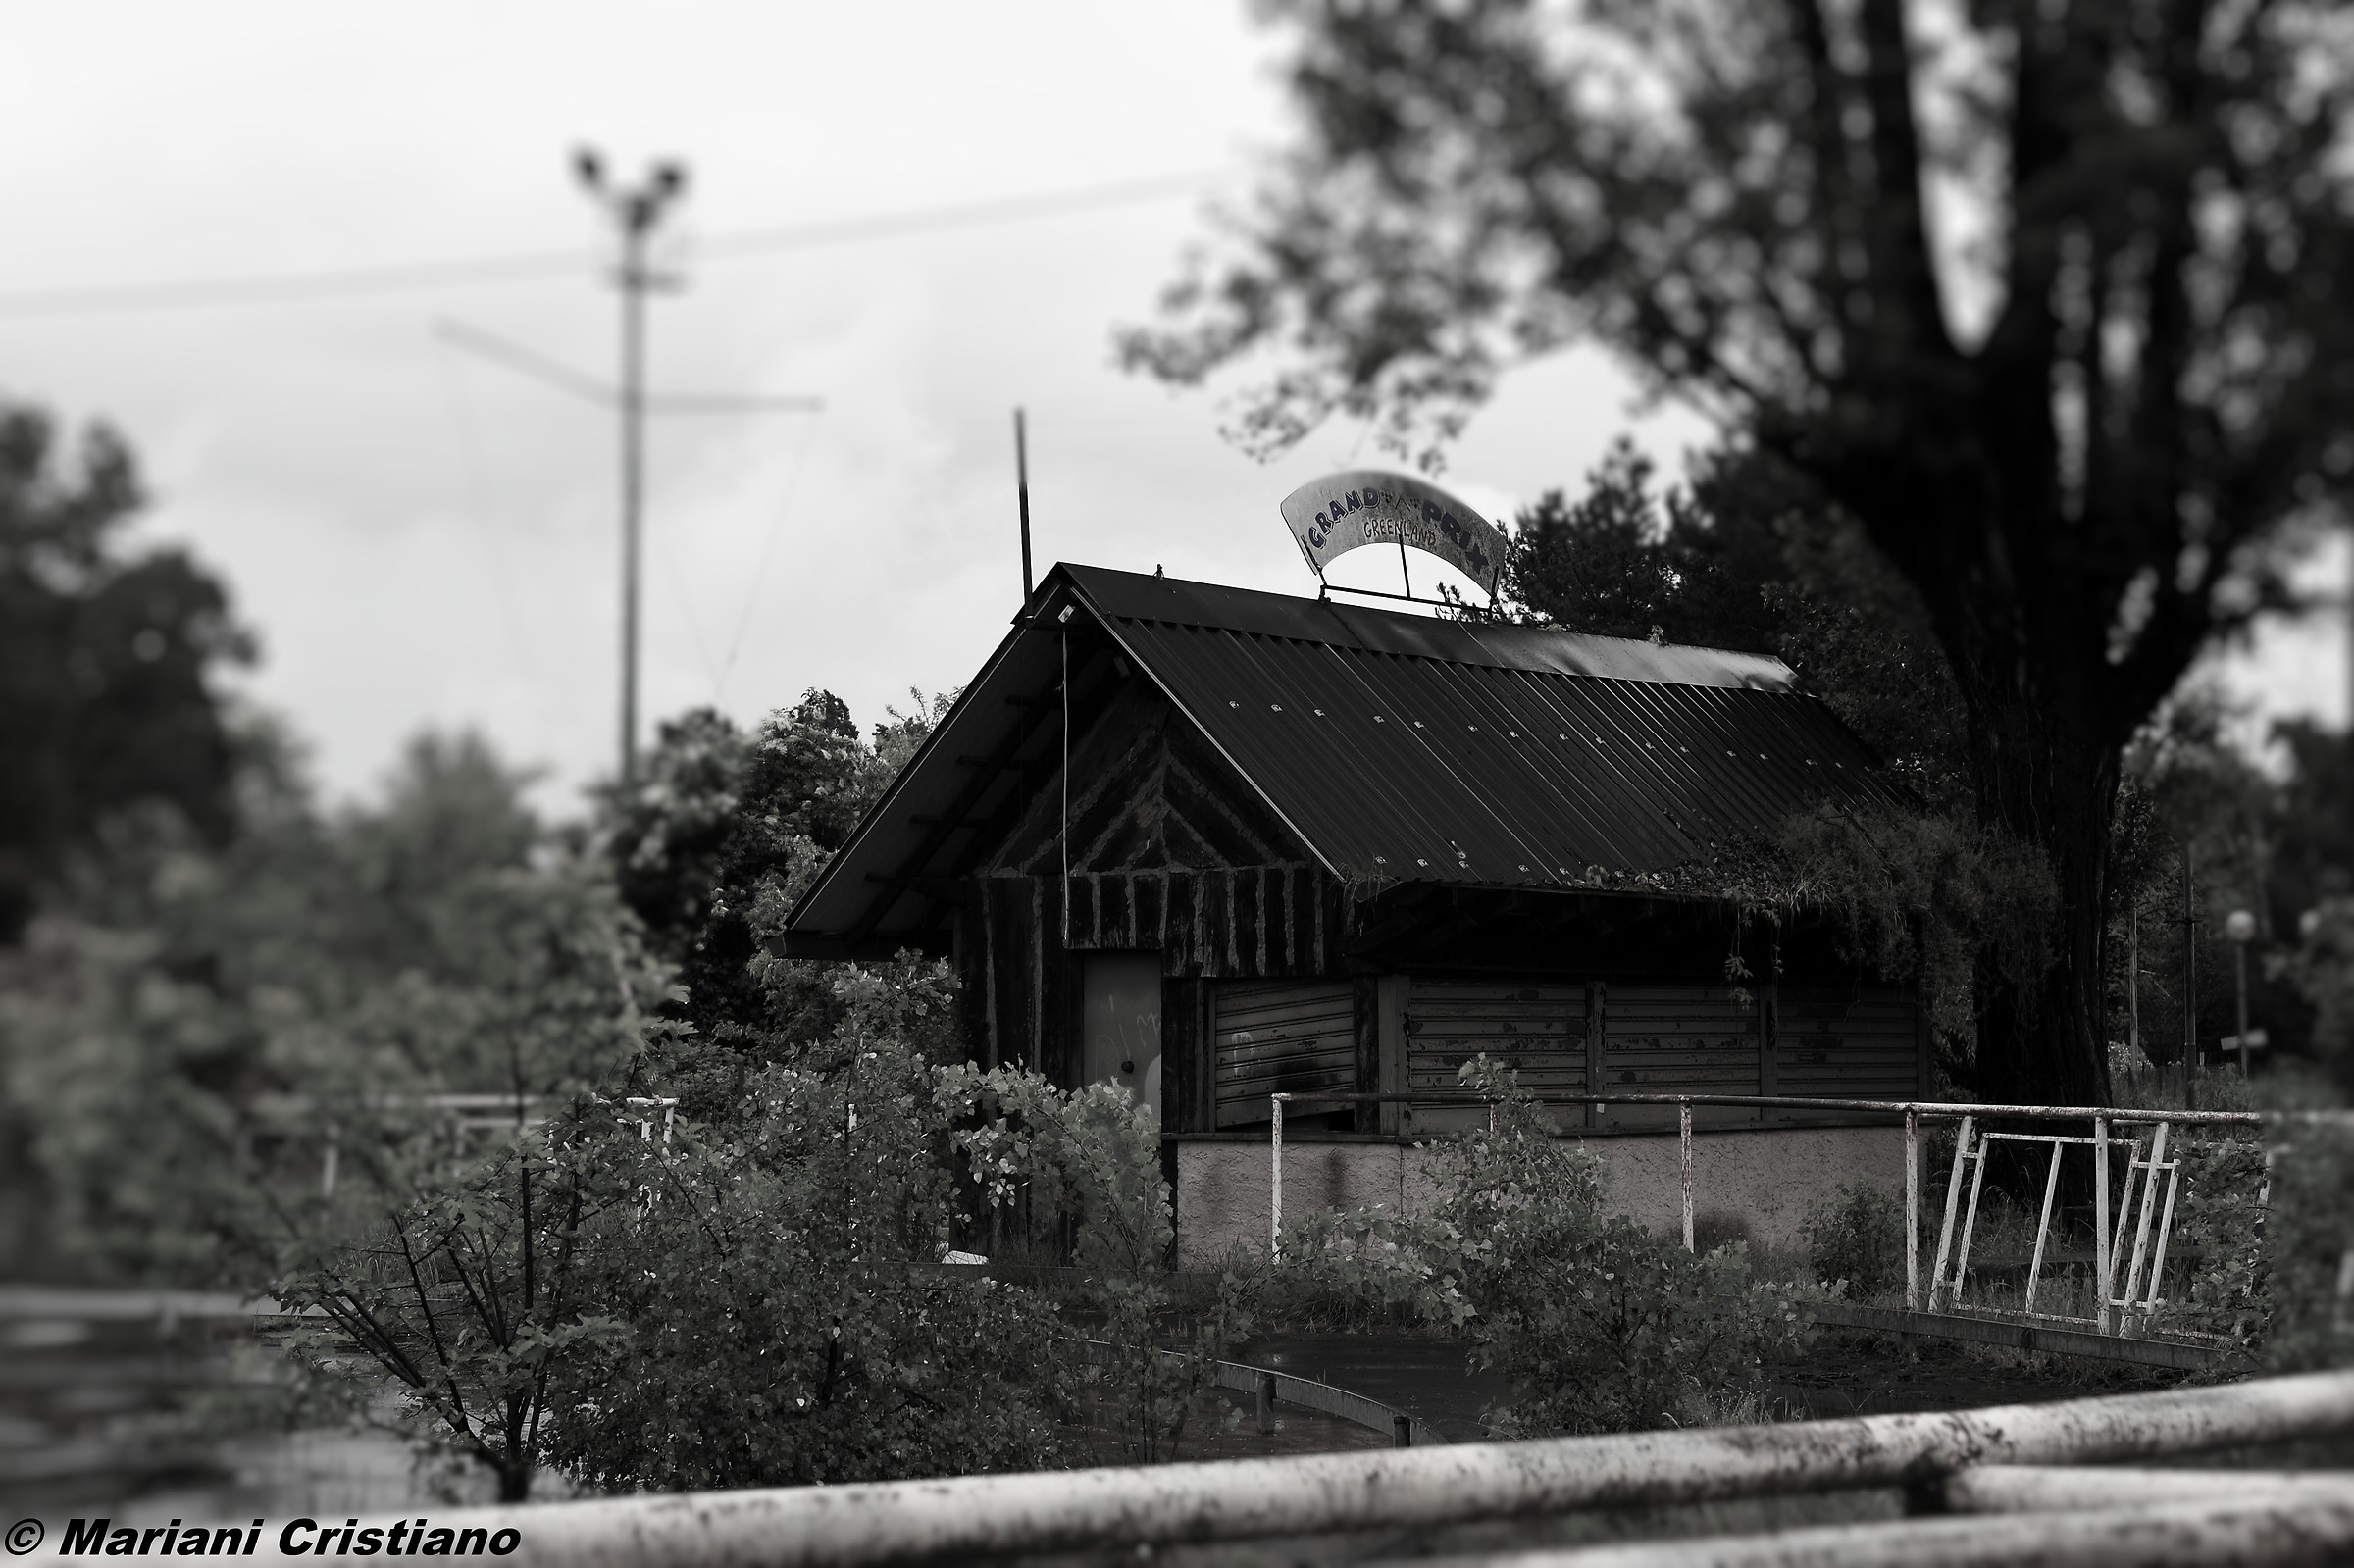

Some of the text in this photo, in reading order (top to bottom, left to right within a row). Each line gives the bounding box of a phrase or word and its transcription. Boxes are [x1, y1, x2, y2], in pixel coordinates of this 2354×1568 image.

[1308, 487, 1489, 575] GRAND PRIX
[1364, 517, 1437, 546] GREENLAND
